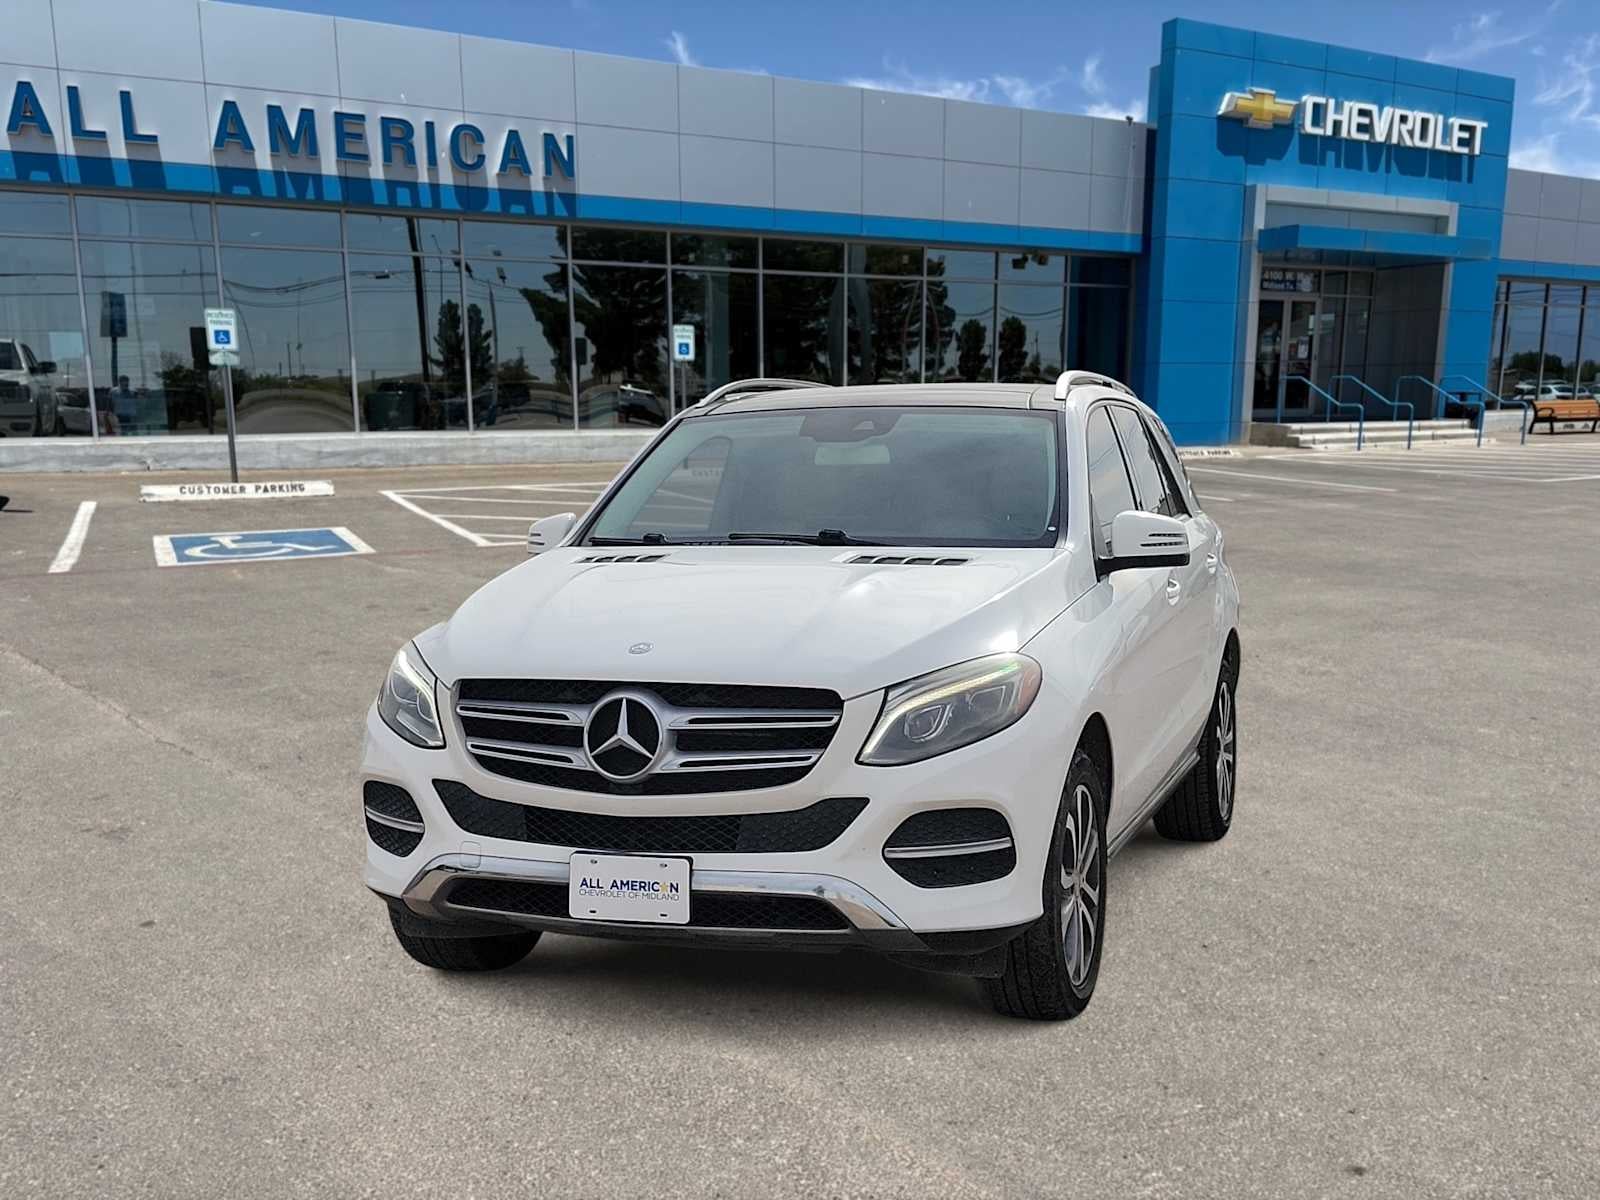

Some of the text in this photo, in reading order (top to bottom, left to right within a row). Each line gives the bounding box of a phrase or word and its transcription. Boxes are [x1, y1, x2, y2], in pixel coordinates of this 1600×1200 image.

[6, 80, 576, 179] ALL AMERICAN
[1301, 94, 1488, 156] CHEVROLET
[179, 483, 306, 496] CUSTOMER PARKING
[580, 877, 679, 893] ALL AMERICN
[579, 888, 679, 901] CHEVROLET OF MIDLAND
